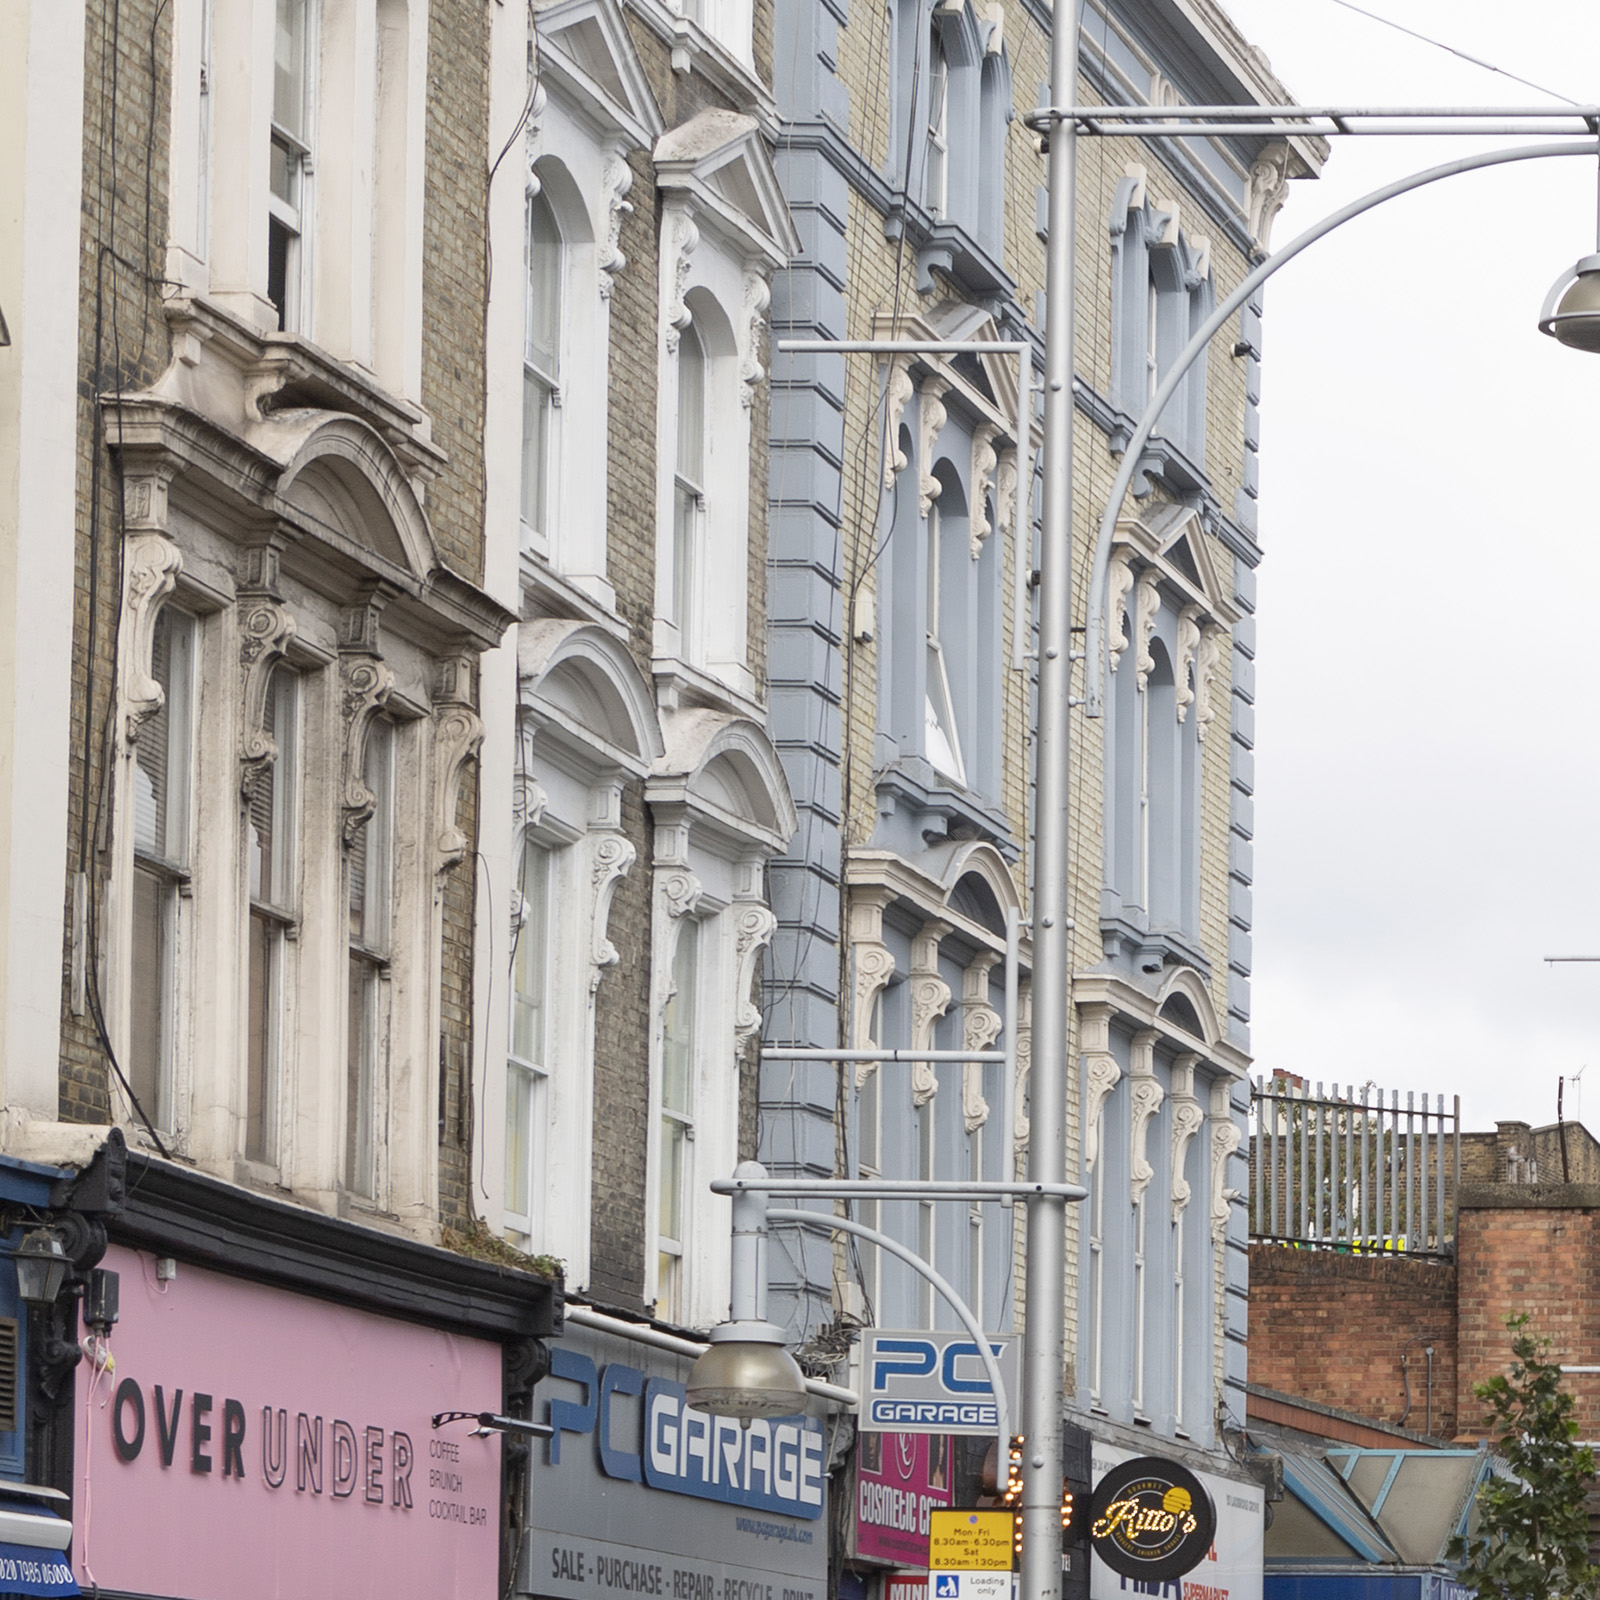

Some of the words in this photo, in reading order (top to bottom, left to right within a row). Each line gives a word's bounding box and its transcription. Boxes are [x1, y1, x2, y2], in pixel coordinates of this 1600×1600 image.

[871, 1337, 1009, 1396] PC
[549, 1346, 645, 1483] PC
[876, 1403, 997, 1423] GARAGE
[113, 1377, 246, 1478] OVER
[263, 1405, 414, 1509] UNDER
[429, 1439, 460, 1463] COFFEE
[650, 1392, 822, 1506] GARAGE
[429, 1468, 463, 1493] BRUNCH
[429, 1499, 468, 1524] COCKTAIL
[470, 1506, 487, 1527] BAR
[963, 1548, 979, 1557] Sat
[0, 1557, 17, 1581] 020
[16, 1560, 42, 1583] 7985
[41, 1562, 74, 1585] 0600
[551, 1547, 585, 1582] SALE
[596, 1556, 662, 1596] PURCHASE
[970, 1577, 1005, 1586] Loading
[977, 1587, 996, 1596] only
